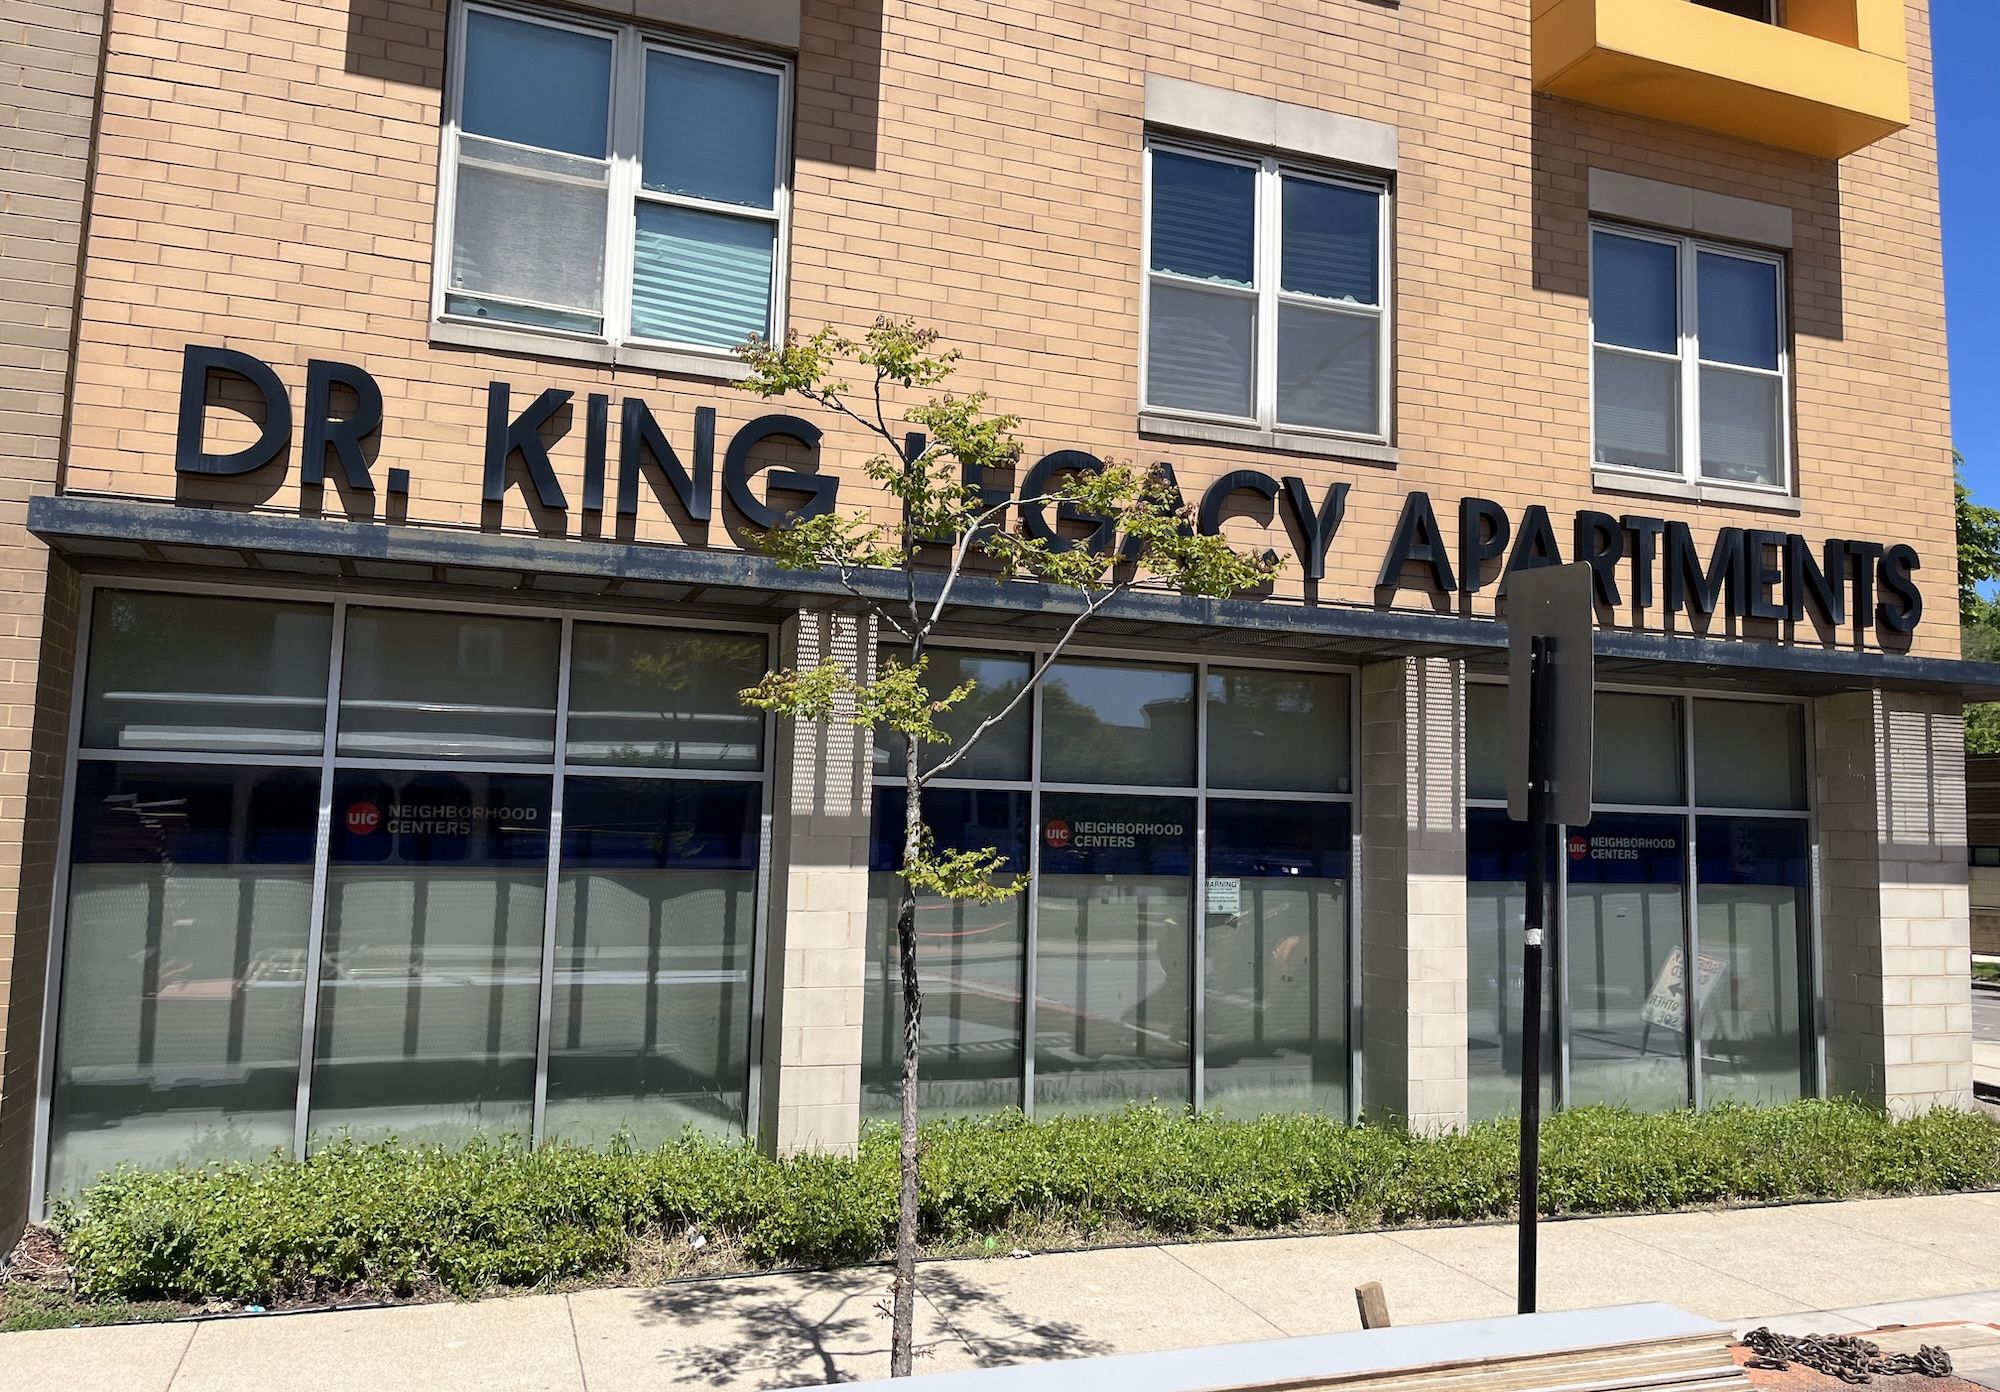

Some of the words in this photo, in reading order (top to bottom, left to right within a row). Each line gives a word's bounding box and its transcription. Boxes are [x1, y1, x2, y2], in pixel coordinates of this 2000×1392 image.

[175, 344, 410, 494] DR.
[482, 381, 839, 530] KING
[1376, 491, 1923, 632] APARTMENTS
[348, 812, 379, 826] UIC
[388, 804, 538, 821] NEIGHBORHOOD
[387, 820, 471, 835] CENTERS
[1074, 821, 1184, 836] NEIGHBORHOOD
[1047, 829, 1069, 840] UIC
[1074, 835, 1136, 848] CENTERS
[1569, 843, 1587, 853] UIC
[1590, 836, 1676, 849] NEIGHBORHOOD
[1590, 848, 1639, 860] CENTERS
